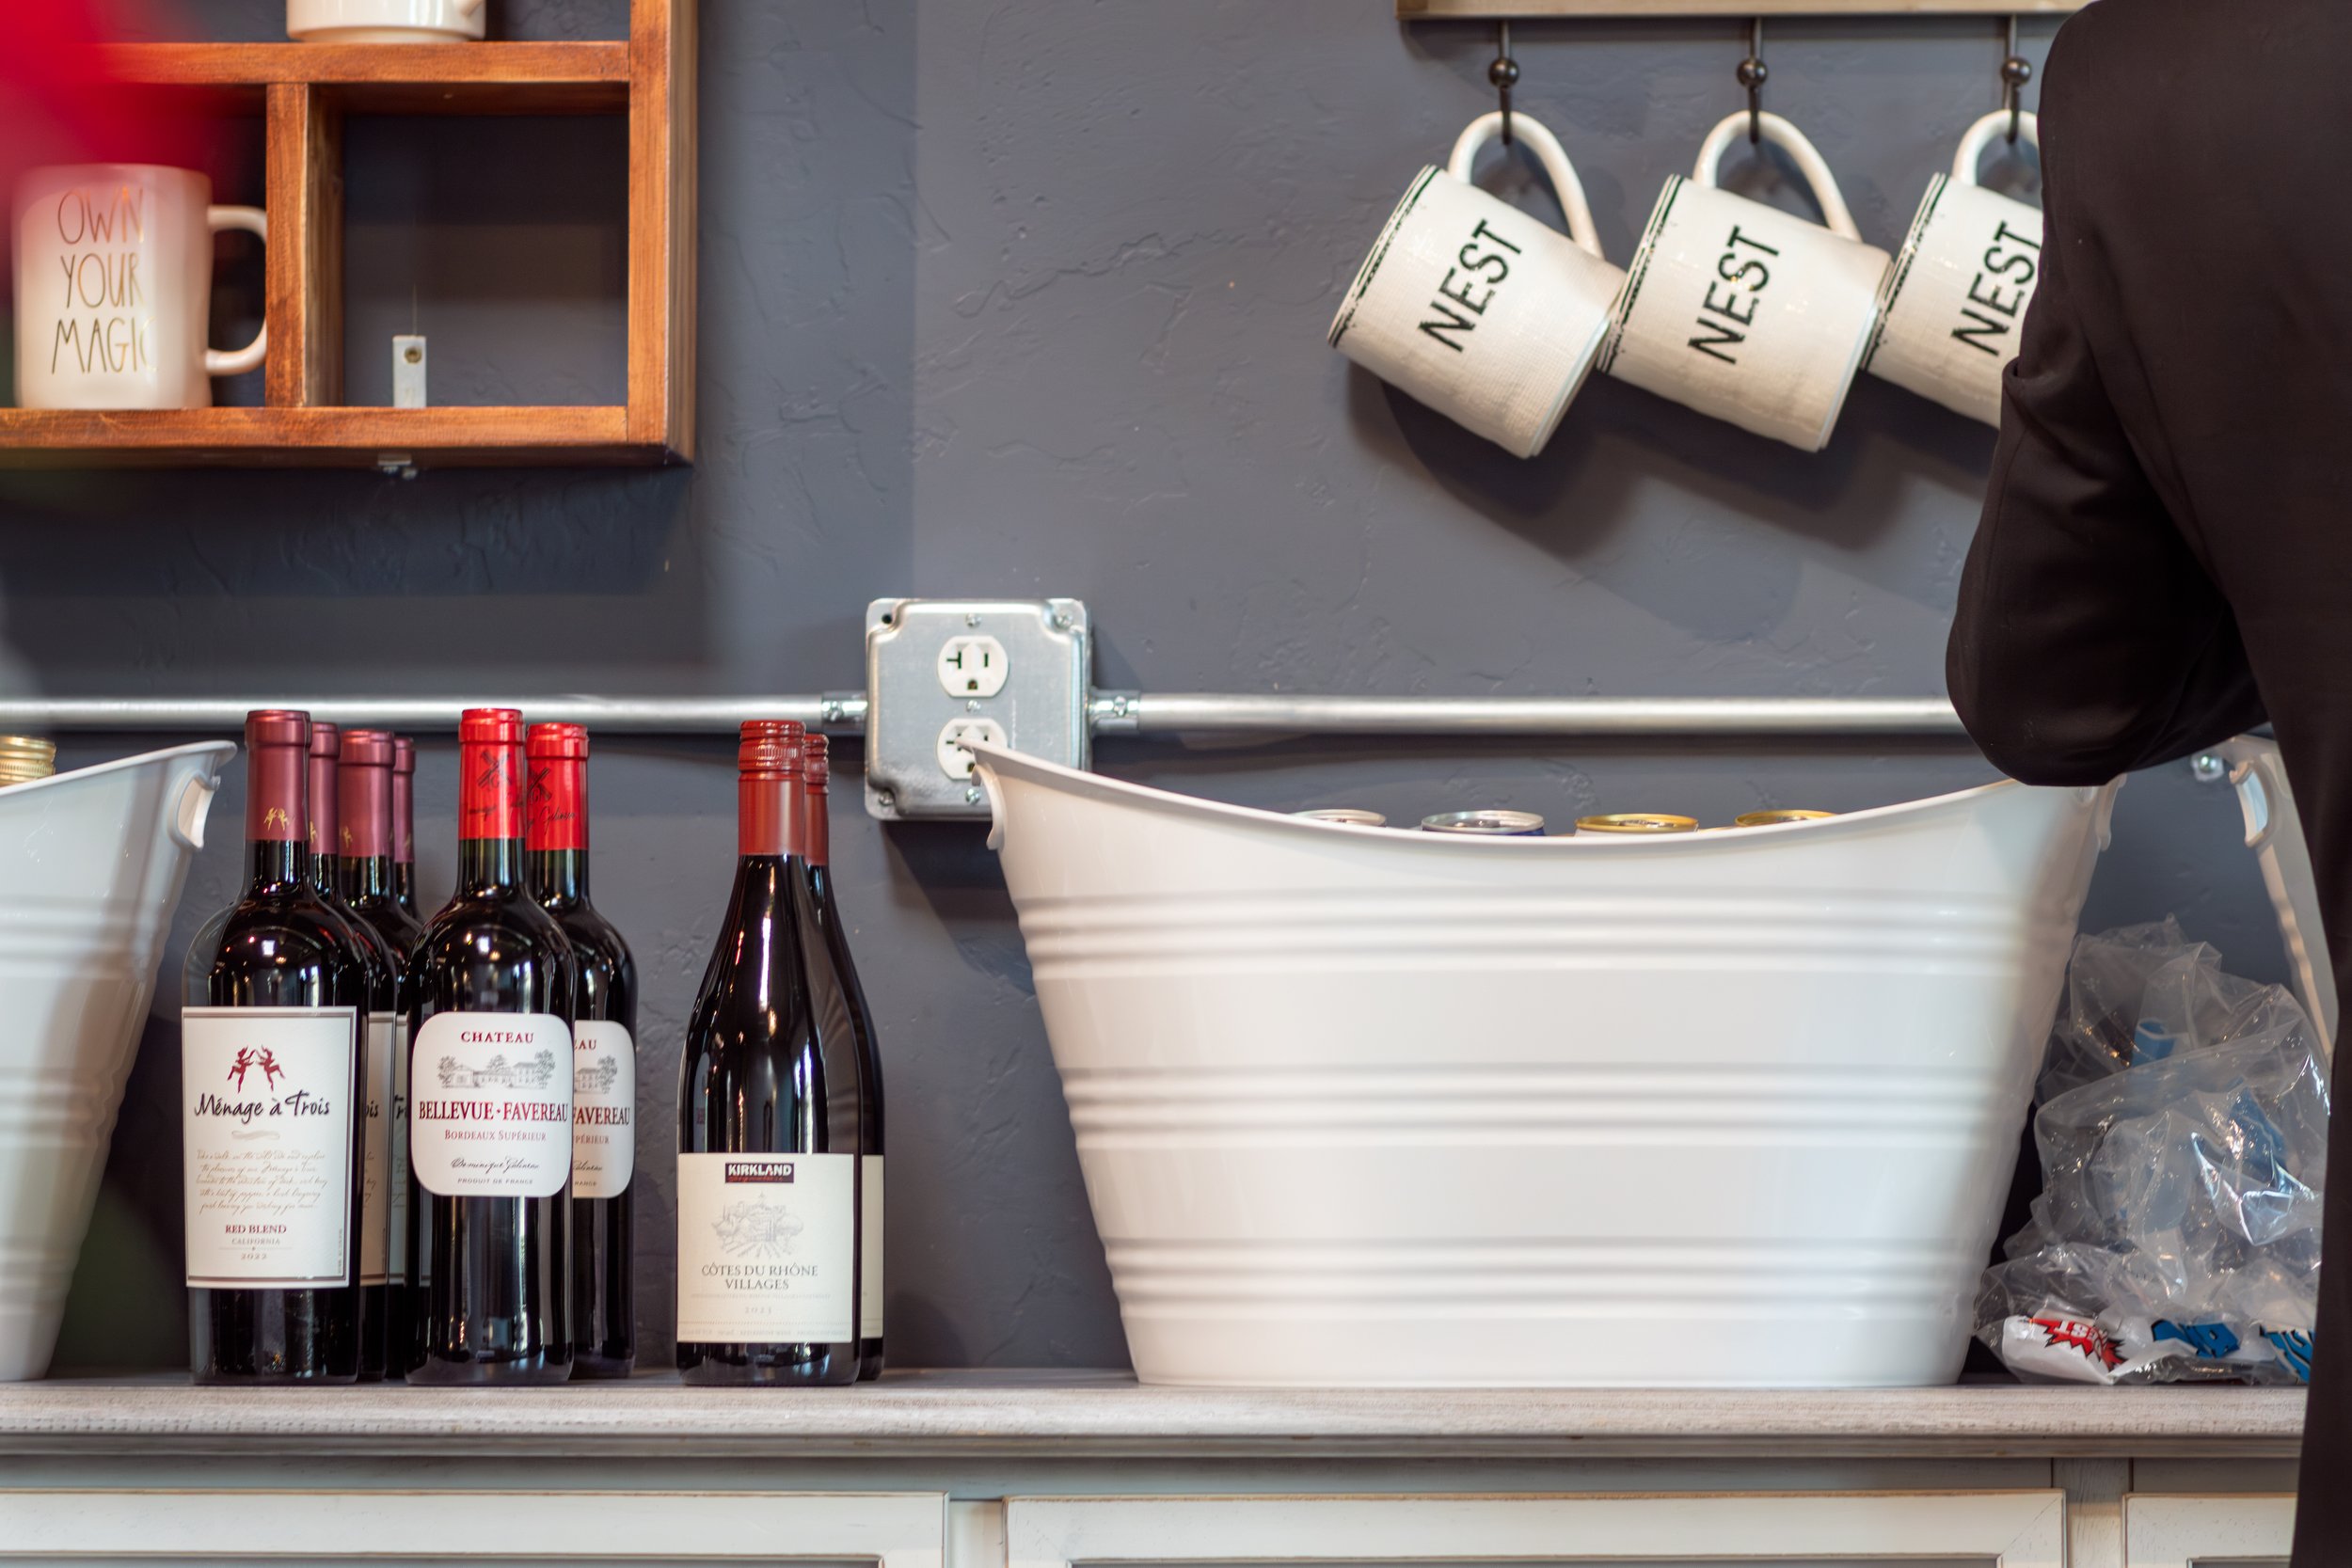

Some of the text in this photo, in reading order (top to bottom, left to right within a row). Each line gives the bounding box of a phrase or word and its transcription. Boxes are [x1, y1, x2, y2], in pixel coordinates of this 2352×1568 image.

[57, 186, 144, 245] OWN
[60, 252, 143, 309] YOUR
[1417, 217, 1522, 353] NEST
[1687, 224, 1780, 365] NEST
[1950, 219, 2041, 356] NEST
[461, 1031, 534, 1044] CHATEAU
[194, 1089, 330, 1125] Ménage à Trois
[419, 1101, 494, 1121] BELLEVUE
[502, 1101, 569, 1123] FAVEREAU
[727, 1164, 793, 1177] KIRKLAND
[225, 1224, 287, 1234] RED BLEND
[701, 1262, 818, 1277] CÔTES DU RHÔNE
[725, 1278, 789, 1291] VILLAGES
